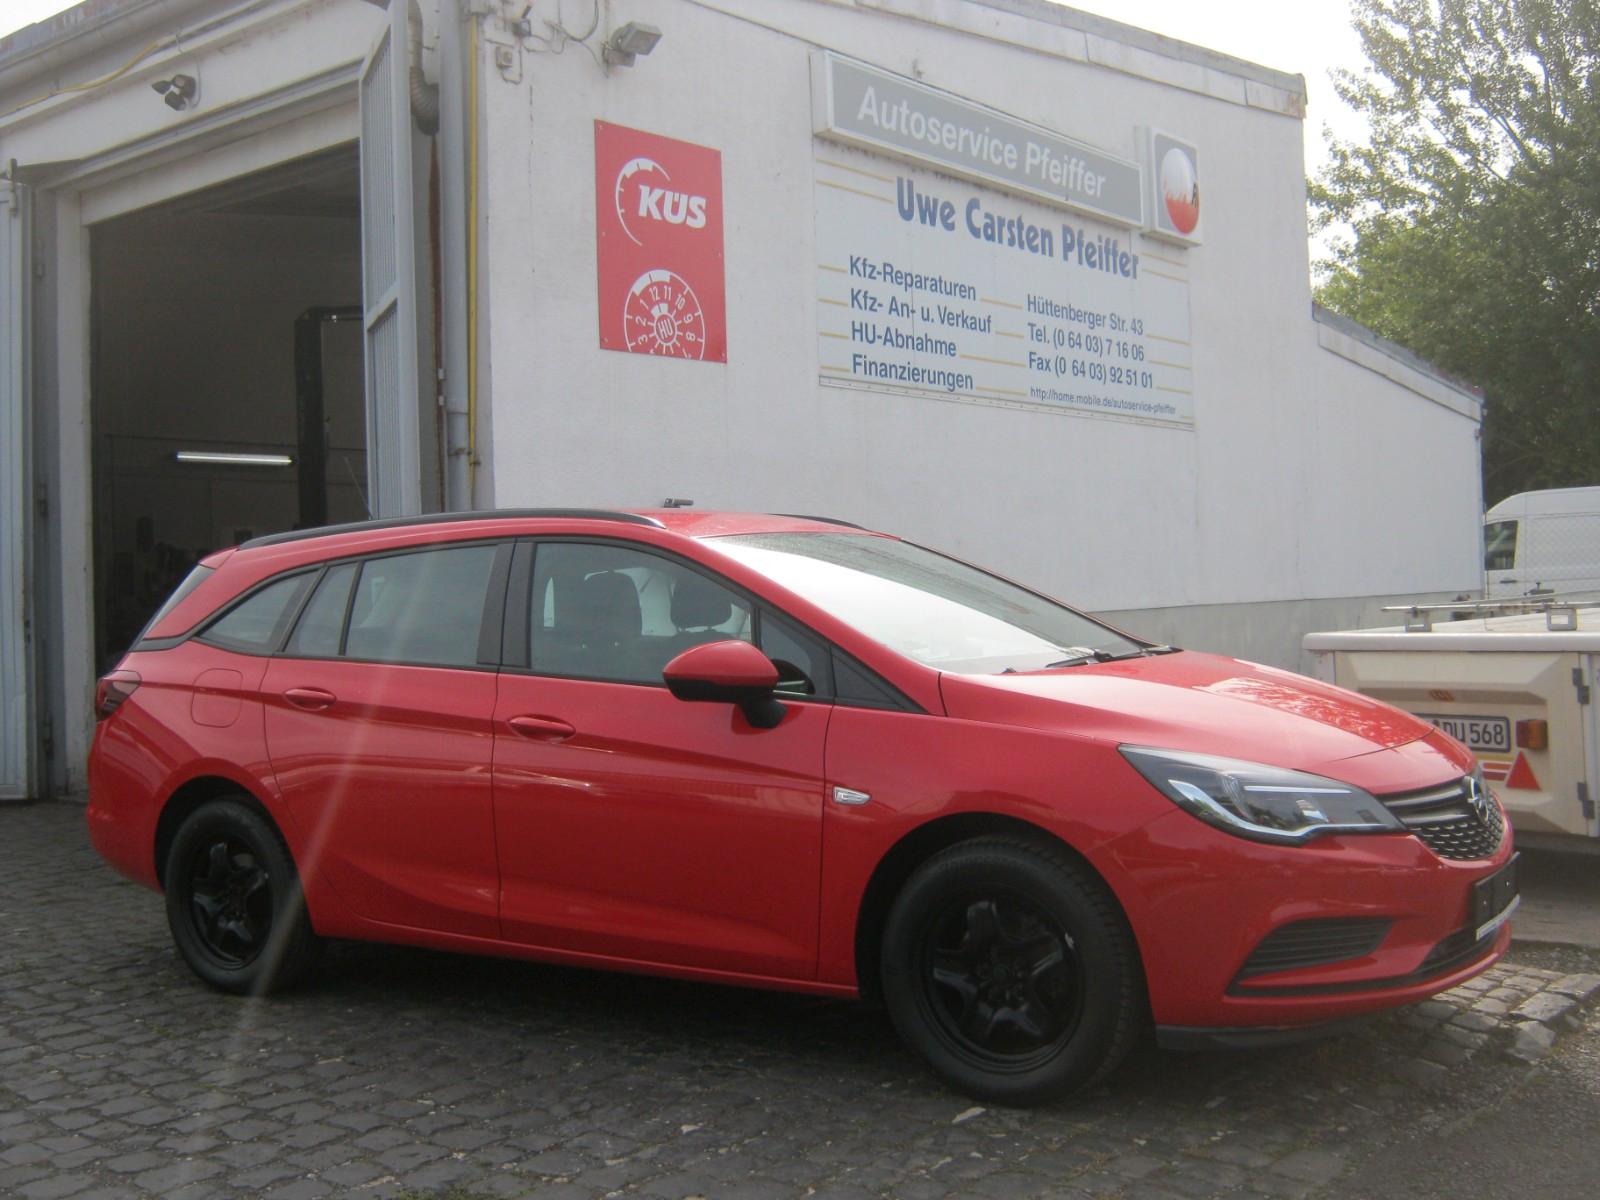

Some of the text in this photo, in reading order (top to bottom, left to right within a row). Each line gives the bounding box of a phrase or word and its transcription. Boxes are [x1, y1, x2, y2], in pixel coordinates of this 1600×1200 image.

[857, 85, 1106, 198] Autoservice Pfeiffer
[638, 184, 707, 229] KÜS
[897, 176, 1139, 280] Uwe Carsten Pfeiffer
[850, 254, 976, 301] Kfz-Reparaturen
[657, 318, 673, 340] HU
[850, 287, 884, 312] Kfz-
[921, 305, 935, 323] u.
[937, 304, 992, 334] Verkauf
[1027, 294, 1144, 336] Hüttenberger Str. 43
[851, 320, 957, 357] HU-Abnahme
[1027, 322, 1050, 344] Tel.
[852, 353, 974, 392] Finanzierungen
[1028, 351, 1051, 372] Fax
[1469, 723, 1504, 745] 568
